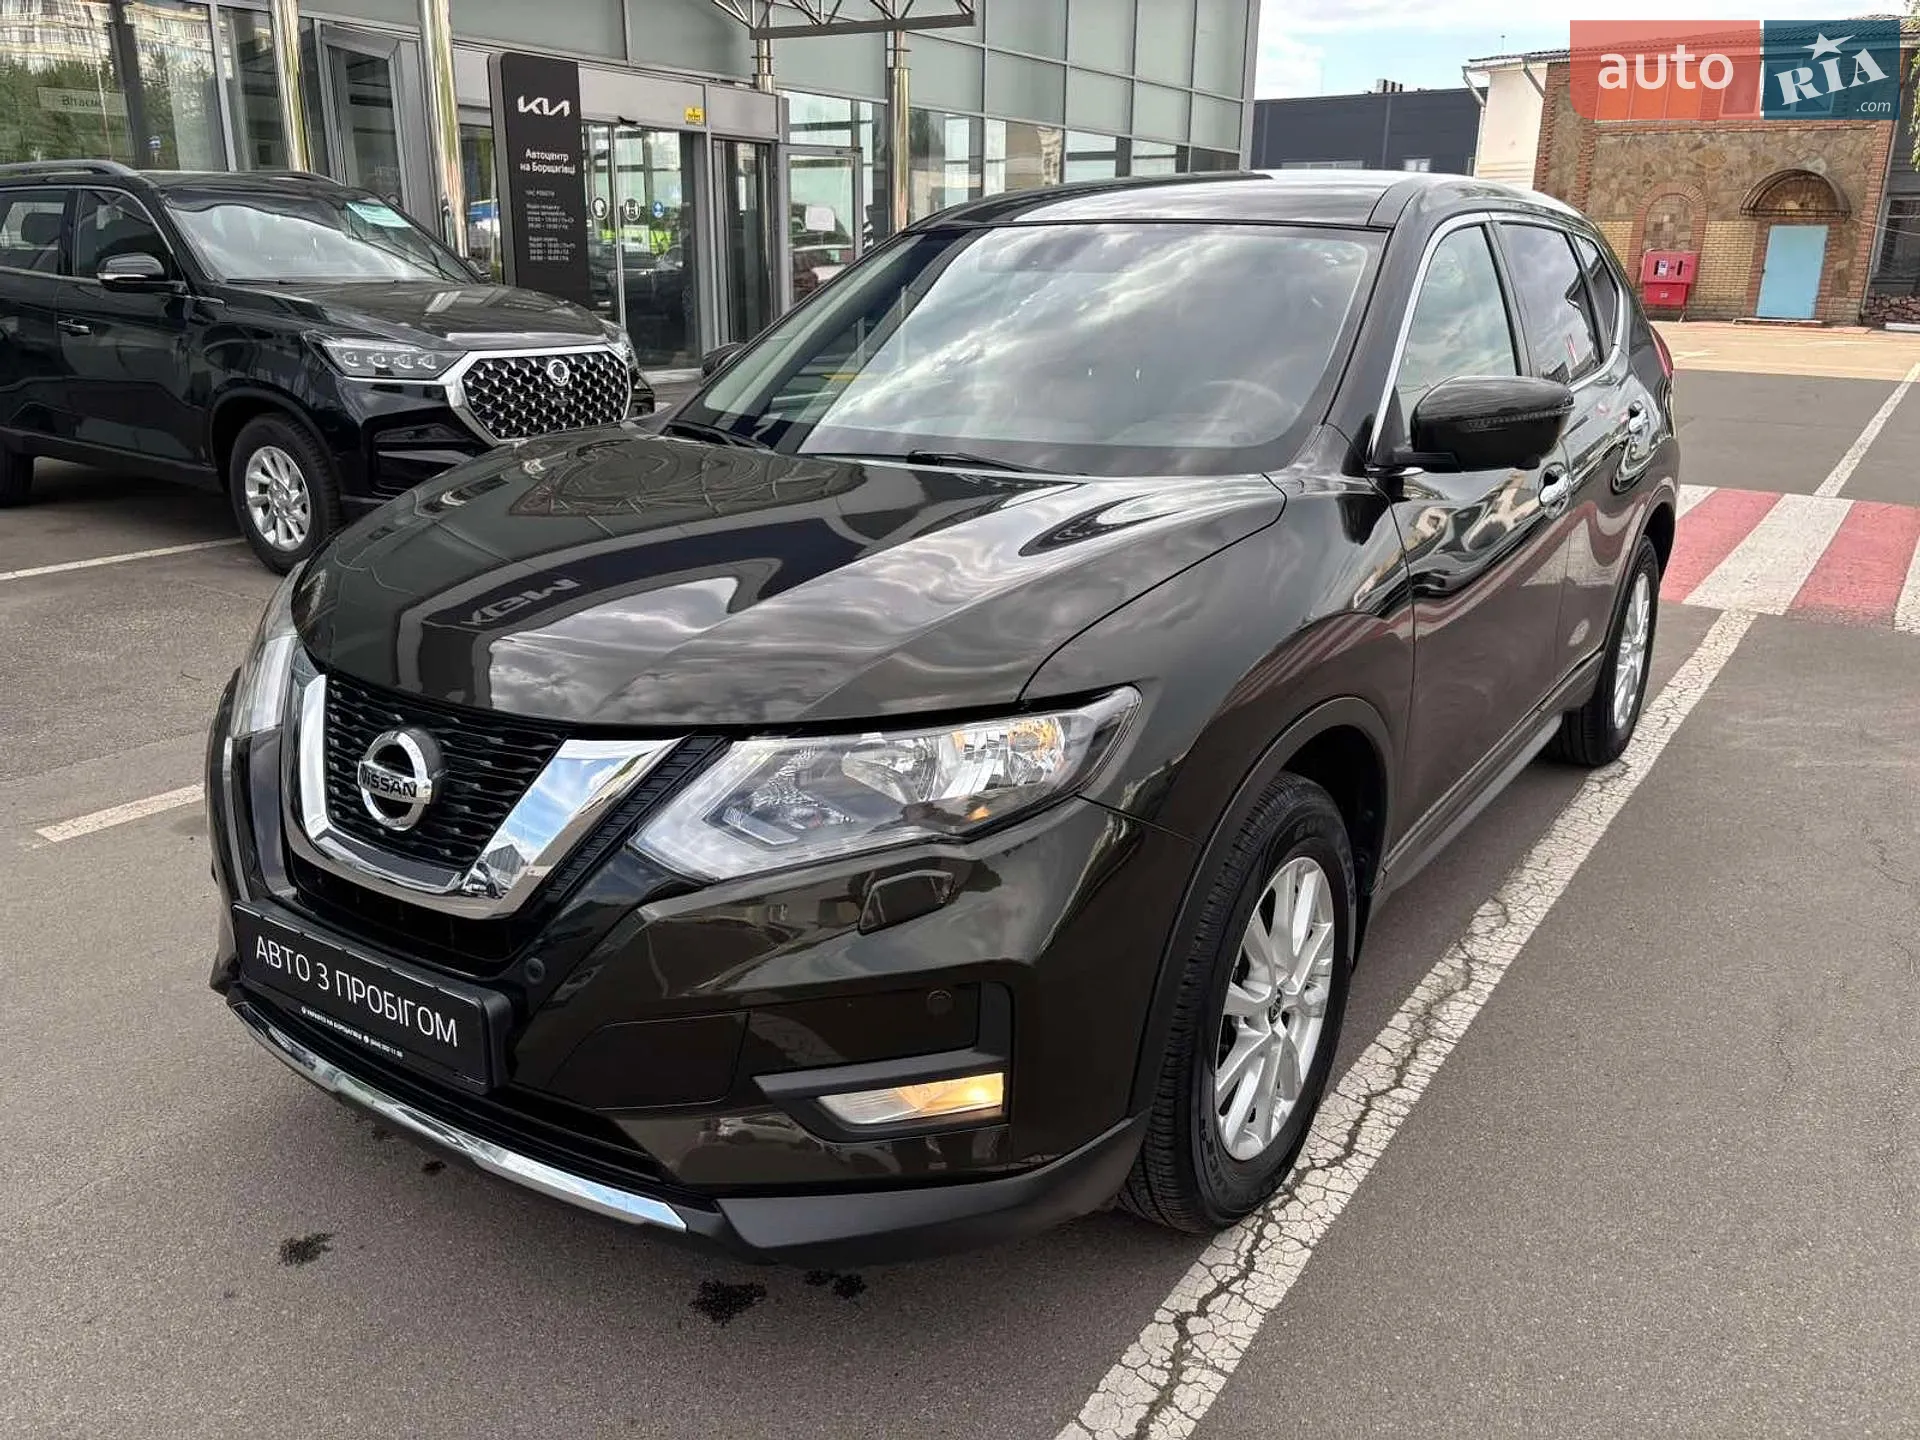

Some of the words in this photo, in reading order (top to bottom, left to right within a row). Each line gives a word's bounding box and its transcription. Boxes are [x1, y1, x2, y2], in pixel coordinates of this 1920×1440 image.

[517, 95, 571, 117] KIA
[525, 148, 569, 163] Автоцентр
[520, 163, 531, 171] на
[360, 765, 418, 797] NISSAN
[255, 935, 311, 983] АВТО
[336, 970, 459, 1047] ПРОБІГОМ
